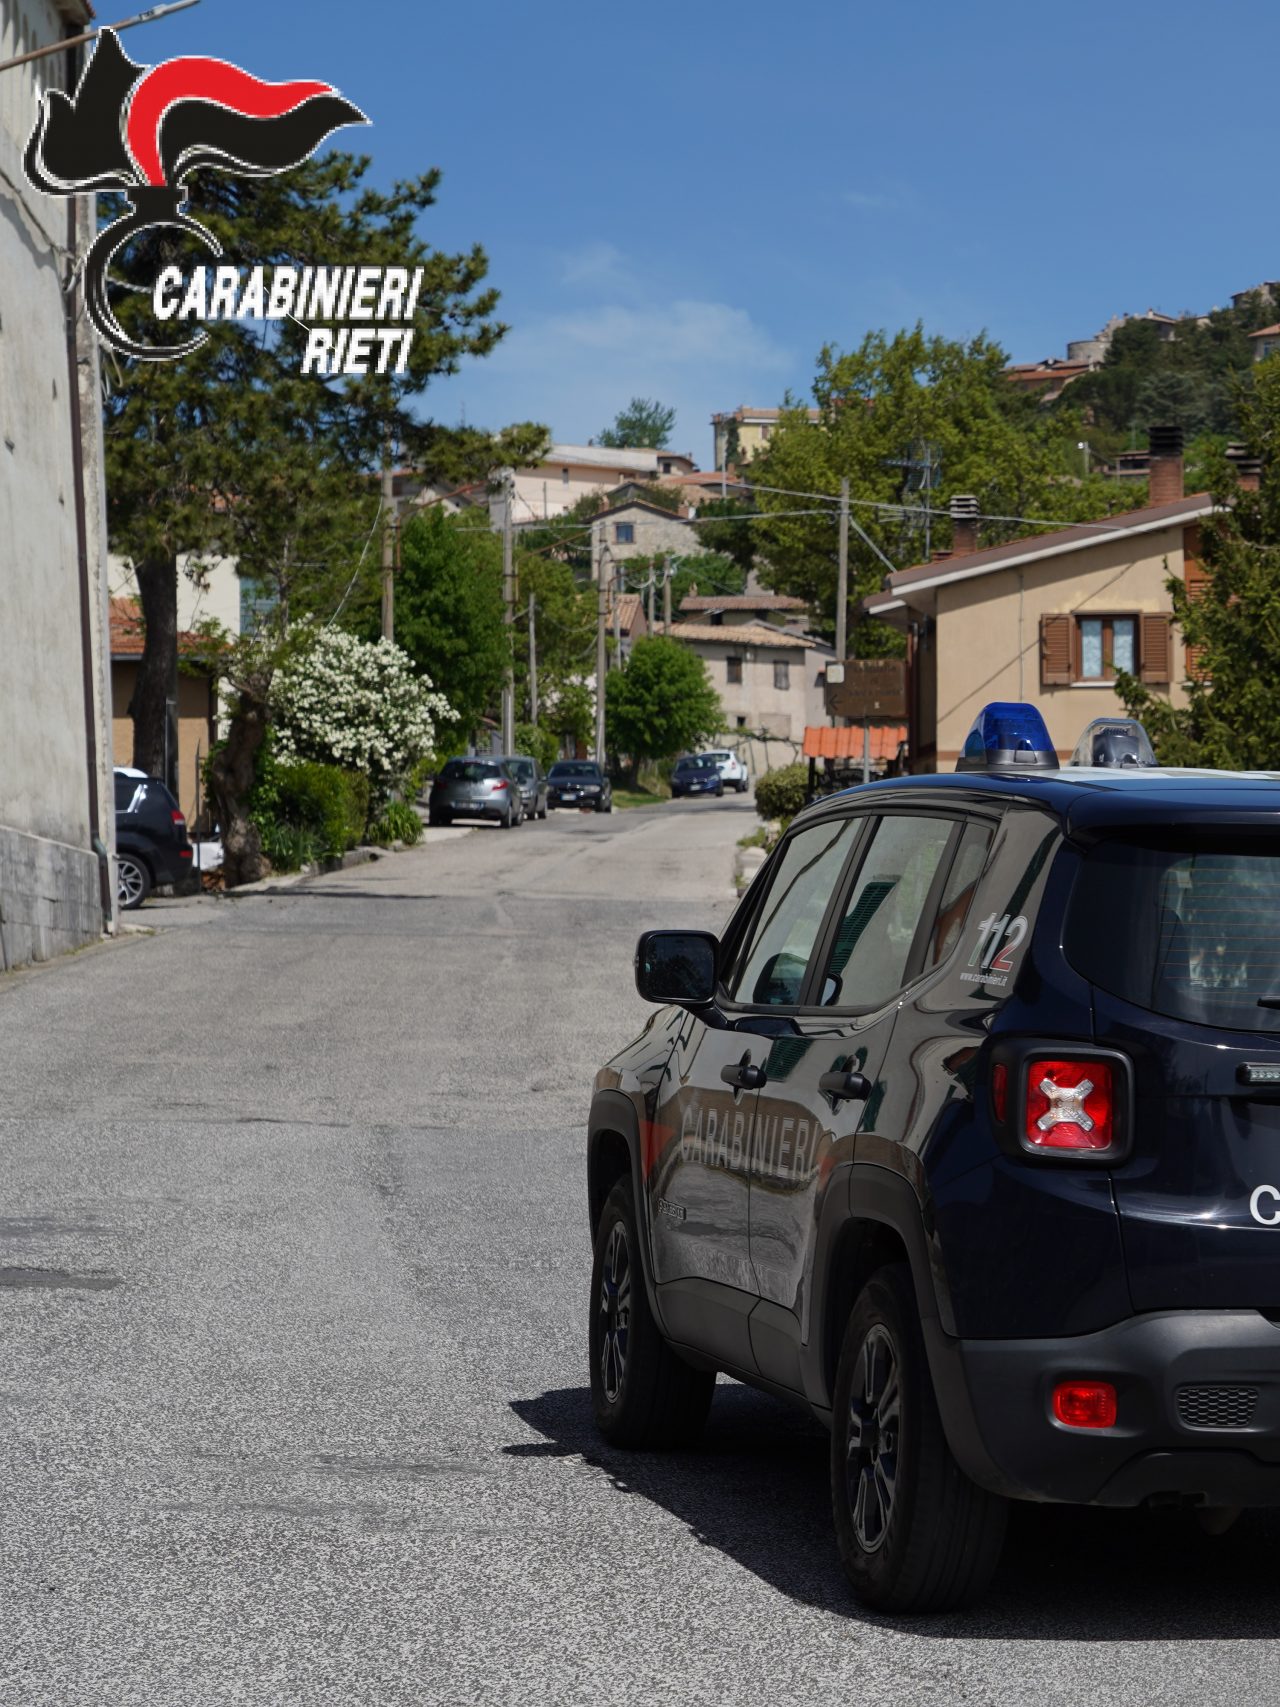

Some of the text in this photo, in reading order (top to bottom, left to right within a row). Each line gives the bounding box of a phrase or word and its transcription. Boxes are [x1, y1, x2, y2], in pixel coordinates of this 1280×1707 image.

[967, 912, 1029, 972] 112
[959, 972, 1009, 987] www.carabinieri.it
[681, 1104, 821, 1183] CARABINIERI
